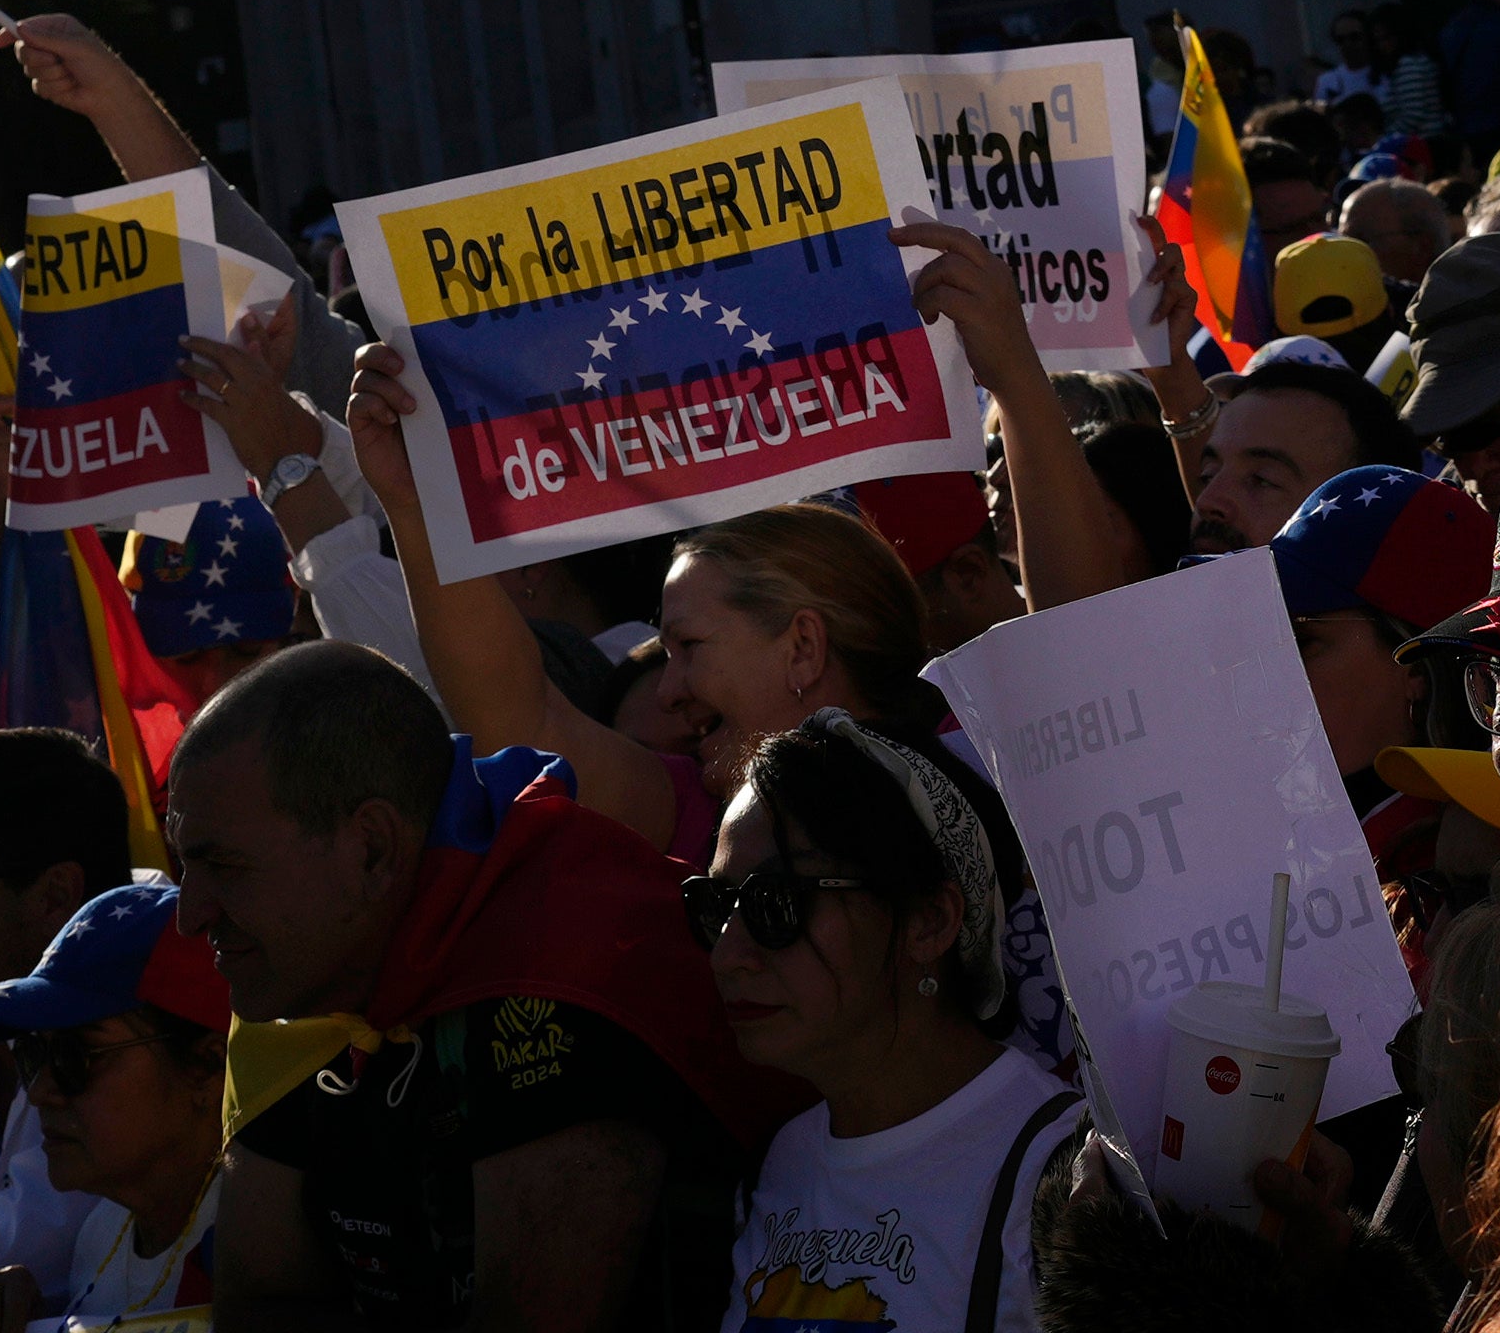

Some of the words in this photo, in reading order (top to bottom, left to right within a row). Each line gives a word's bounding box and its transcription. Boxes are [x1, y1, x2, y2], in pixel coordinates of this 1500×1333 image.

[422, 226, 511, 300] Por
[525, 205, 578, 277] la
[591, 136, 843, 263] LIBERTAD
[501, 438, 567, 502] de
[569, 363, 908, 484] VENEZUELA
[491, 1022, 566, 1075] DAKAR
[510, 1058, 563, 1092] 2024
[759, 1207, 917, 1286] Venezuela
